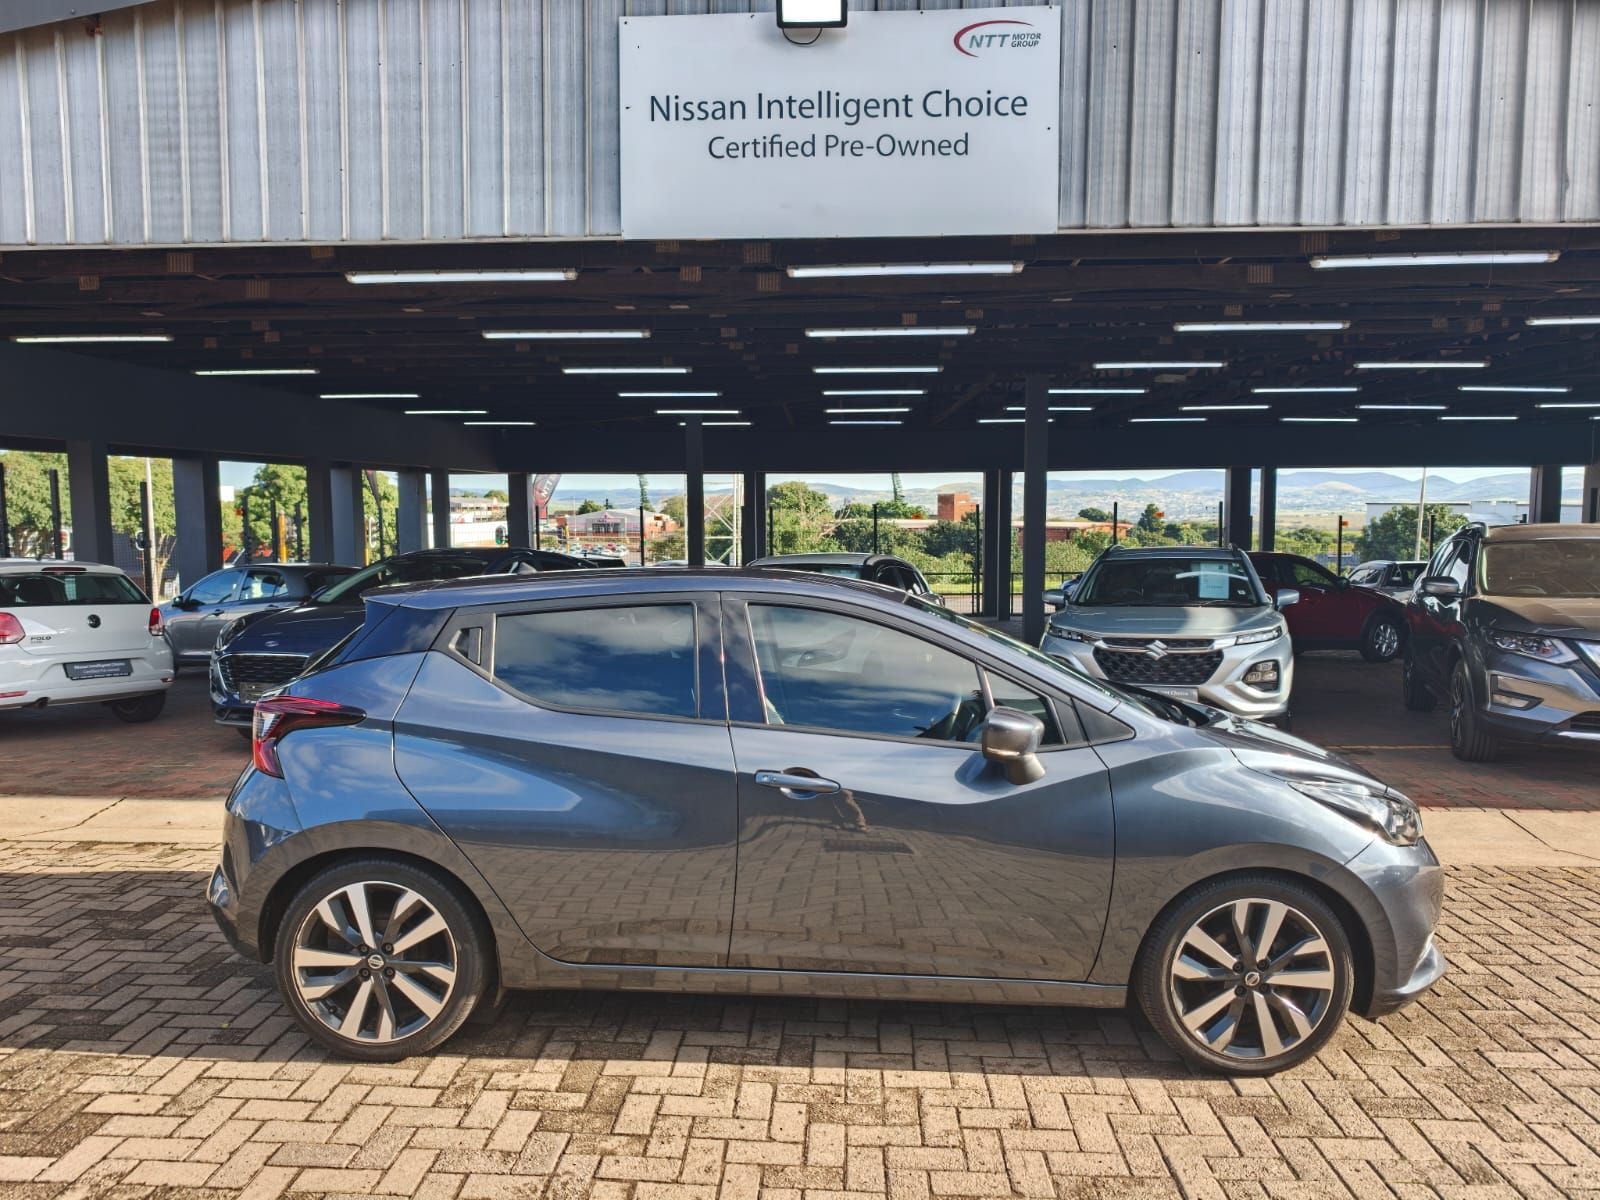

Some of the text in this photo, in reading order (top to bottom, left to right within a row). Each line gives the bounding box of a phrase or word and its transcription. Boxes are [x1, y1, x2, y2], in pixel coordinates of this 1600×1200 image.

[969, 34, 1010, 48] NTT
[1012, 32, 1042, 41] MOTOR
[1011, 40, 1039, 48] GROUP
[650, 88, 1028, 126] Nissan Intelligent Choice
[708, 132, 969, 159] Certified Pre-Owned
